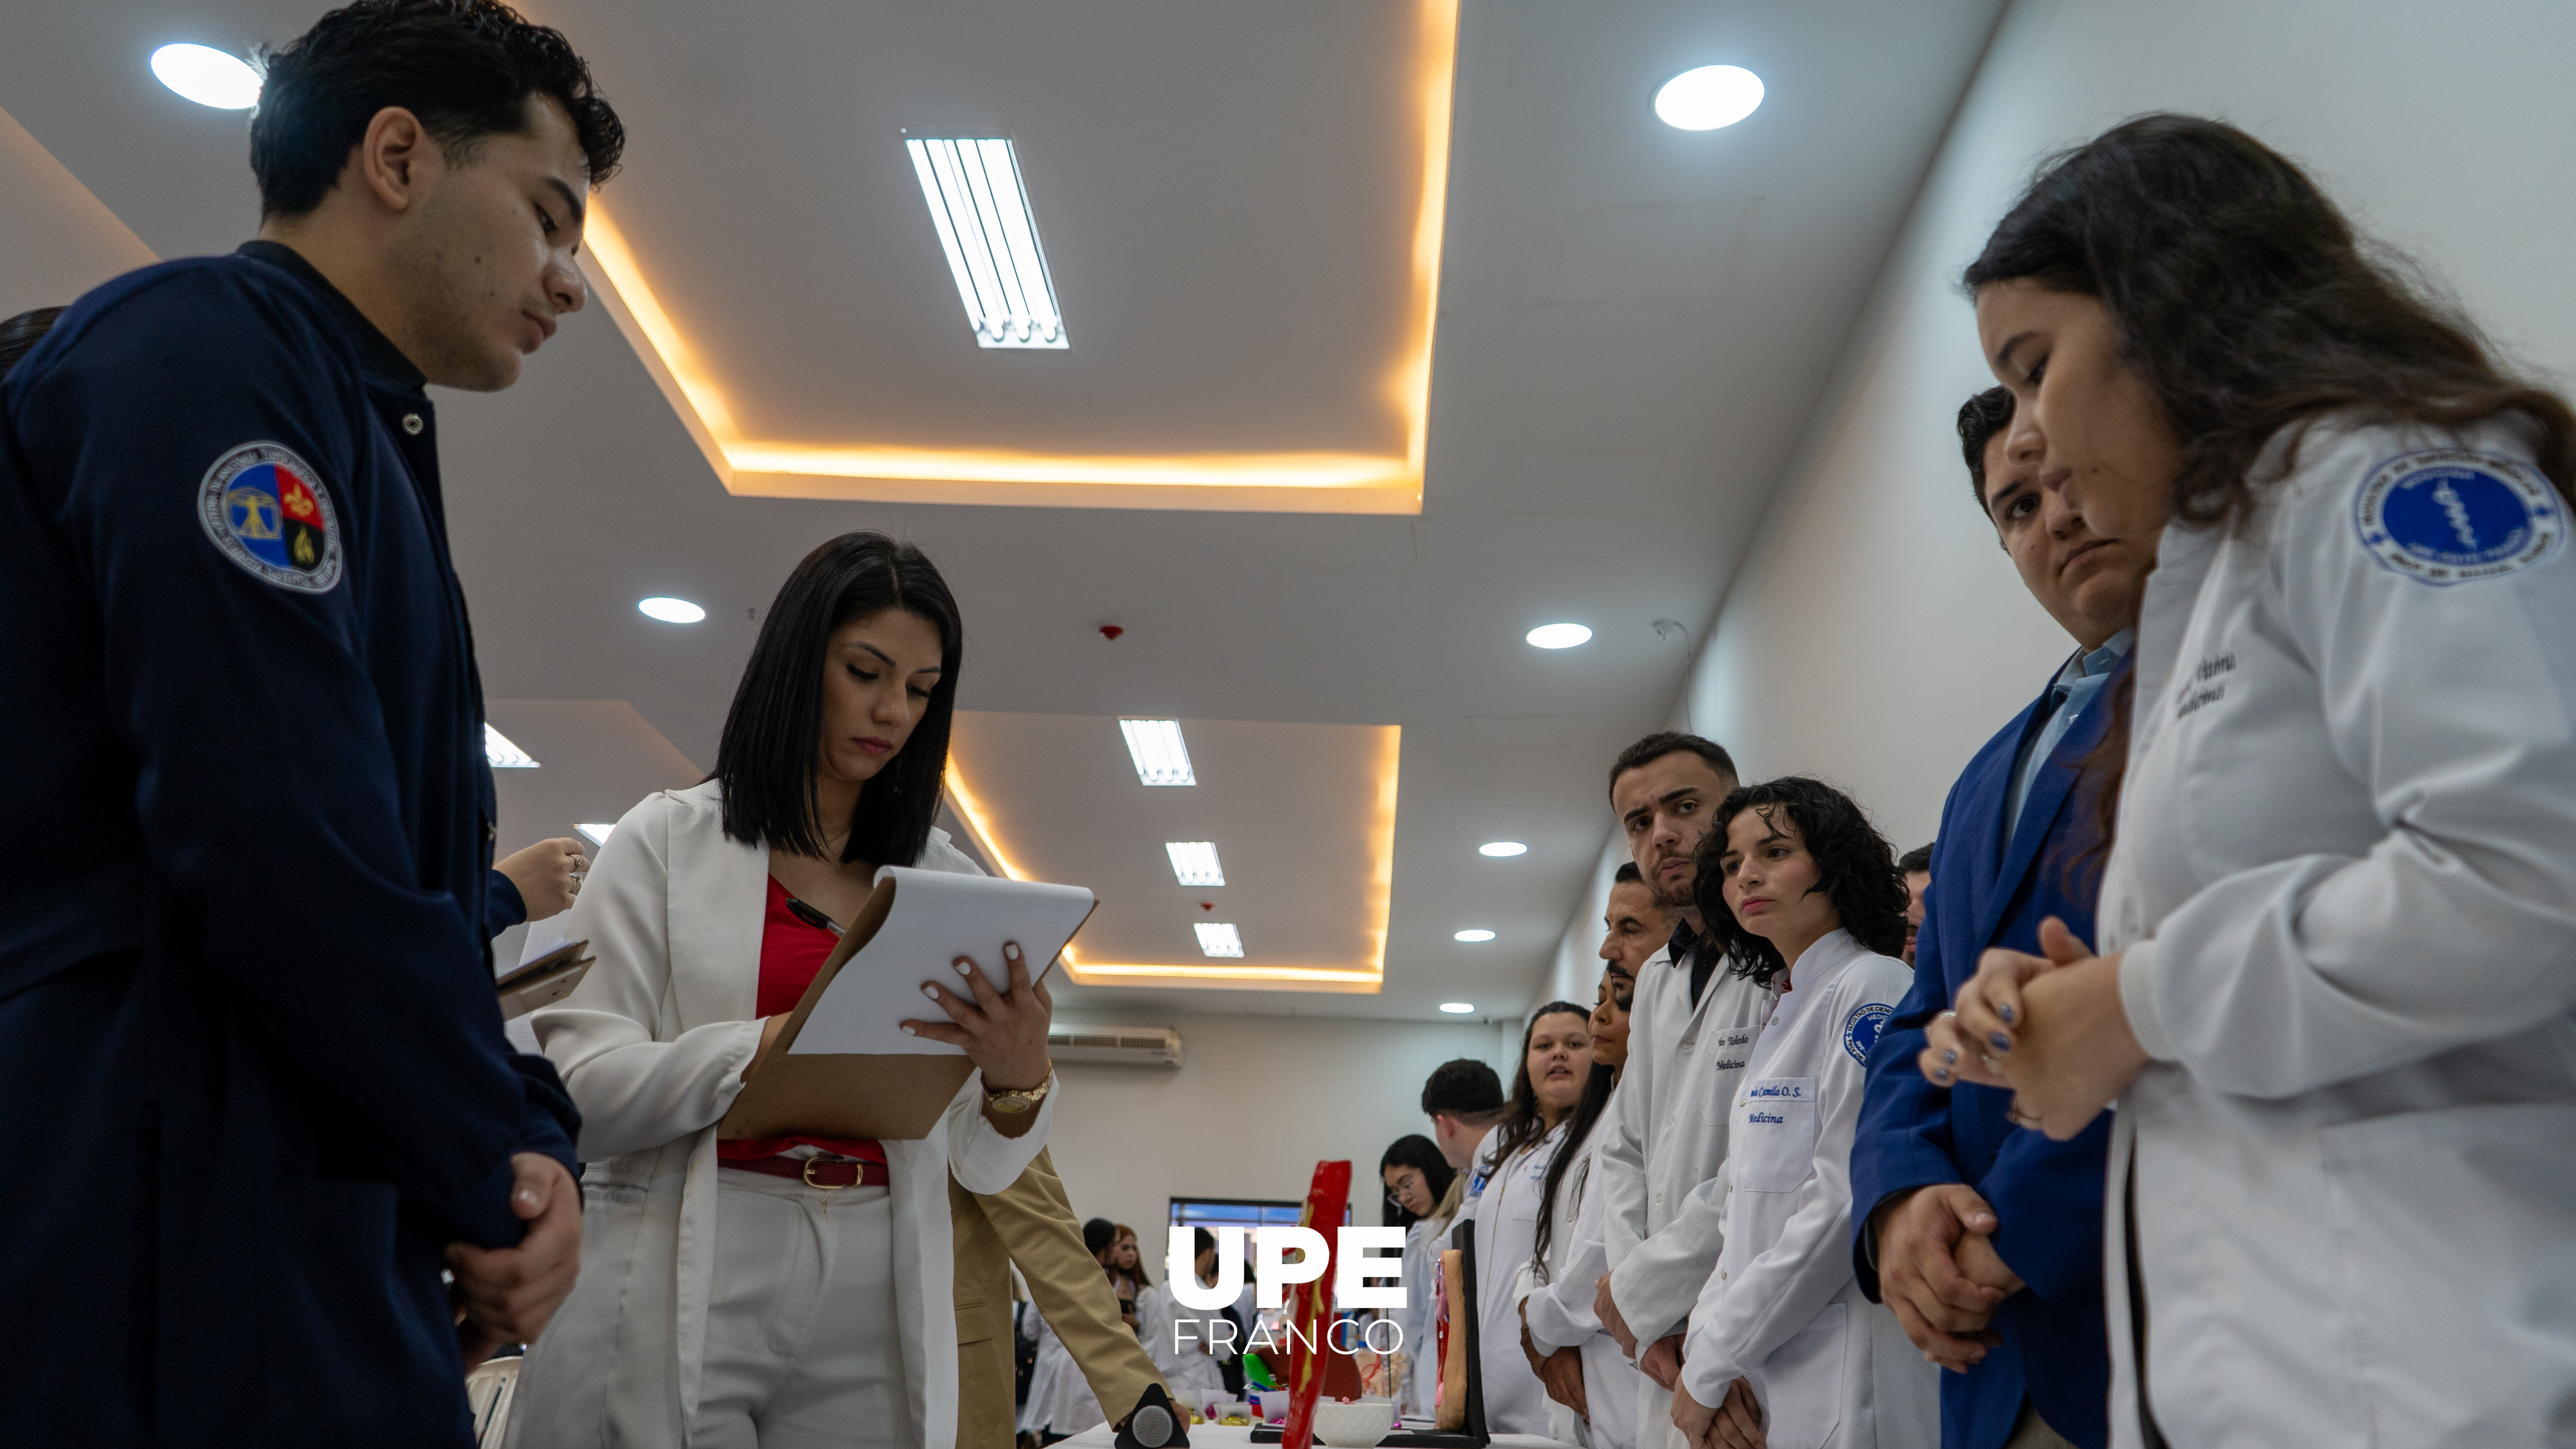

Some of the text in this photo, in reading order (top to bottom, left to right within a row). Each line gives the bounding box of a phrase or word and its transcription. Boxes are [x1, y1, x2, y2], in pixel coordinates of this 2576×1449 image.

[1848, 1010, 1866, 1031] FACULTAD
[1728, 1033, 1749, 1045] Toledo
[1716, 1060, 1745, 1070] Medicina
[1759, 1085, 1779, 1097] Camila
[1782, 1087, 1791, 1096] O.
[1792, 1087, 1801, 1097] S.
